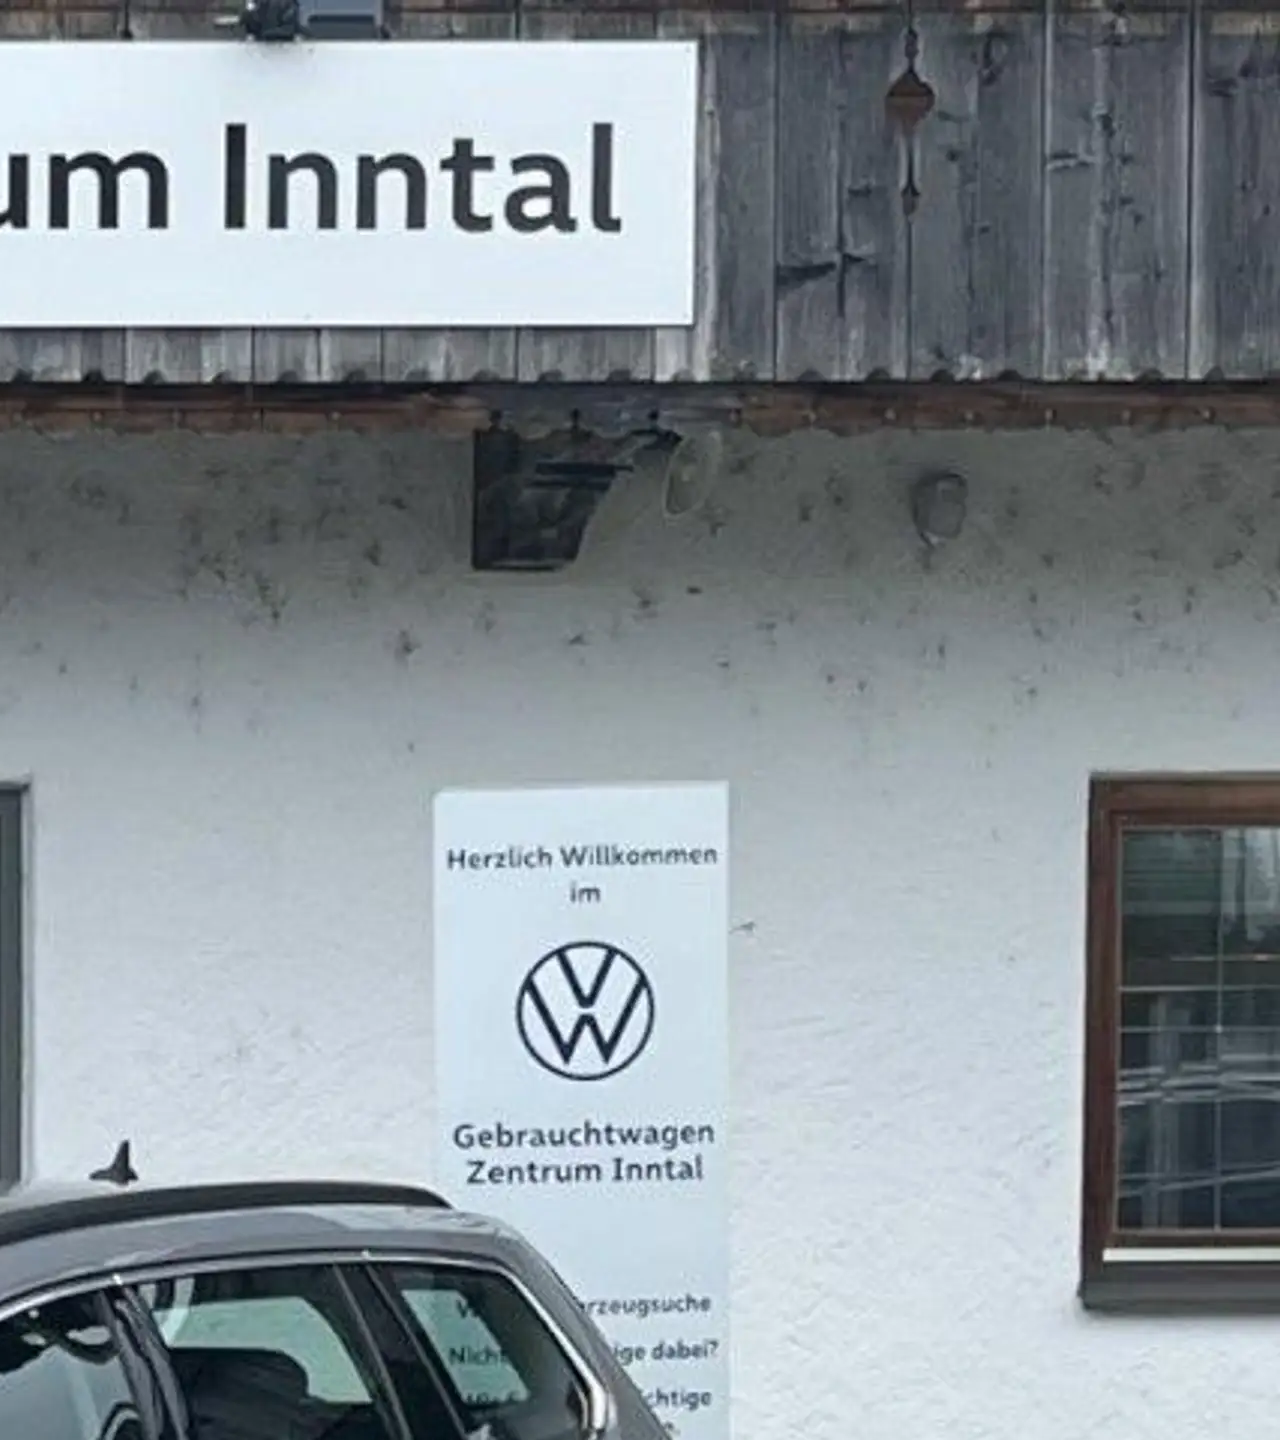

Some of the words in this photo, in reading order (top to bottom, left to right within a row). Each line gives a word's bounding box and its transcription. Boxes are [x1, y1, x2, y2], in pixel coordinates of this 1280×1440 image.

[225, 123, 621, 232] Inntal
[447, 846, 552, 870] Herzlich
[560, 845, 717, 868] Willkommen
[569, 882, 601, 903] im
[453, 1121, 714, 1152] Gebrauchtwagen
[467, 1160, 603, 1184] Zentrum
[613, 1154, 702, 1182] Inntal
[587, 1294, 711, 1317] rzeugsuche
[651, 1339, 719, 1361] dabei?
